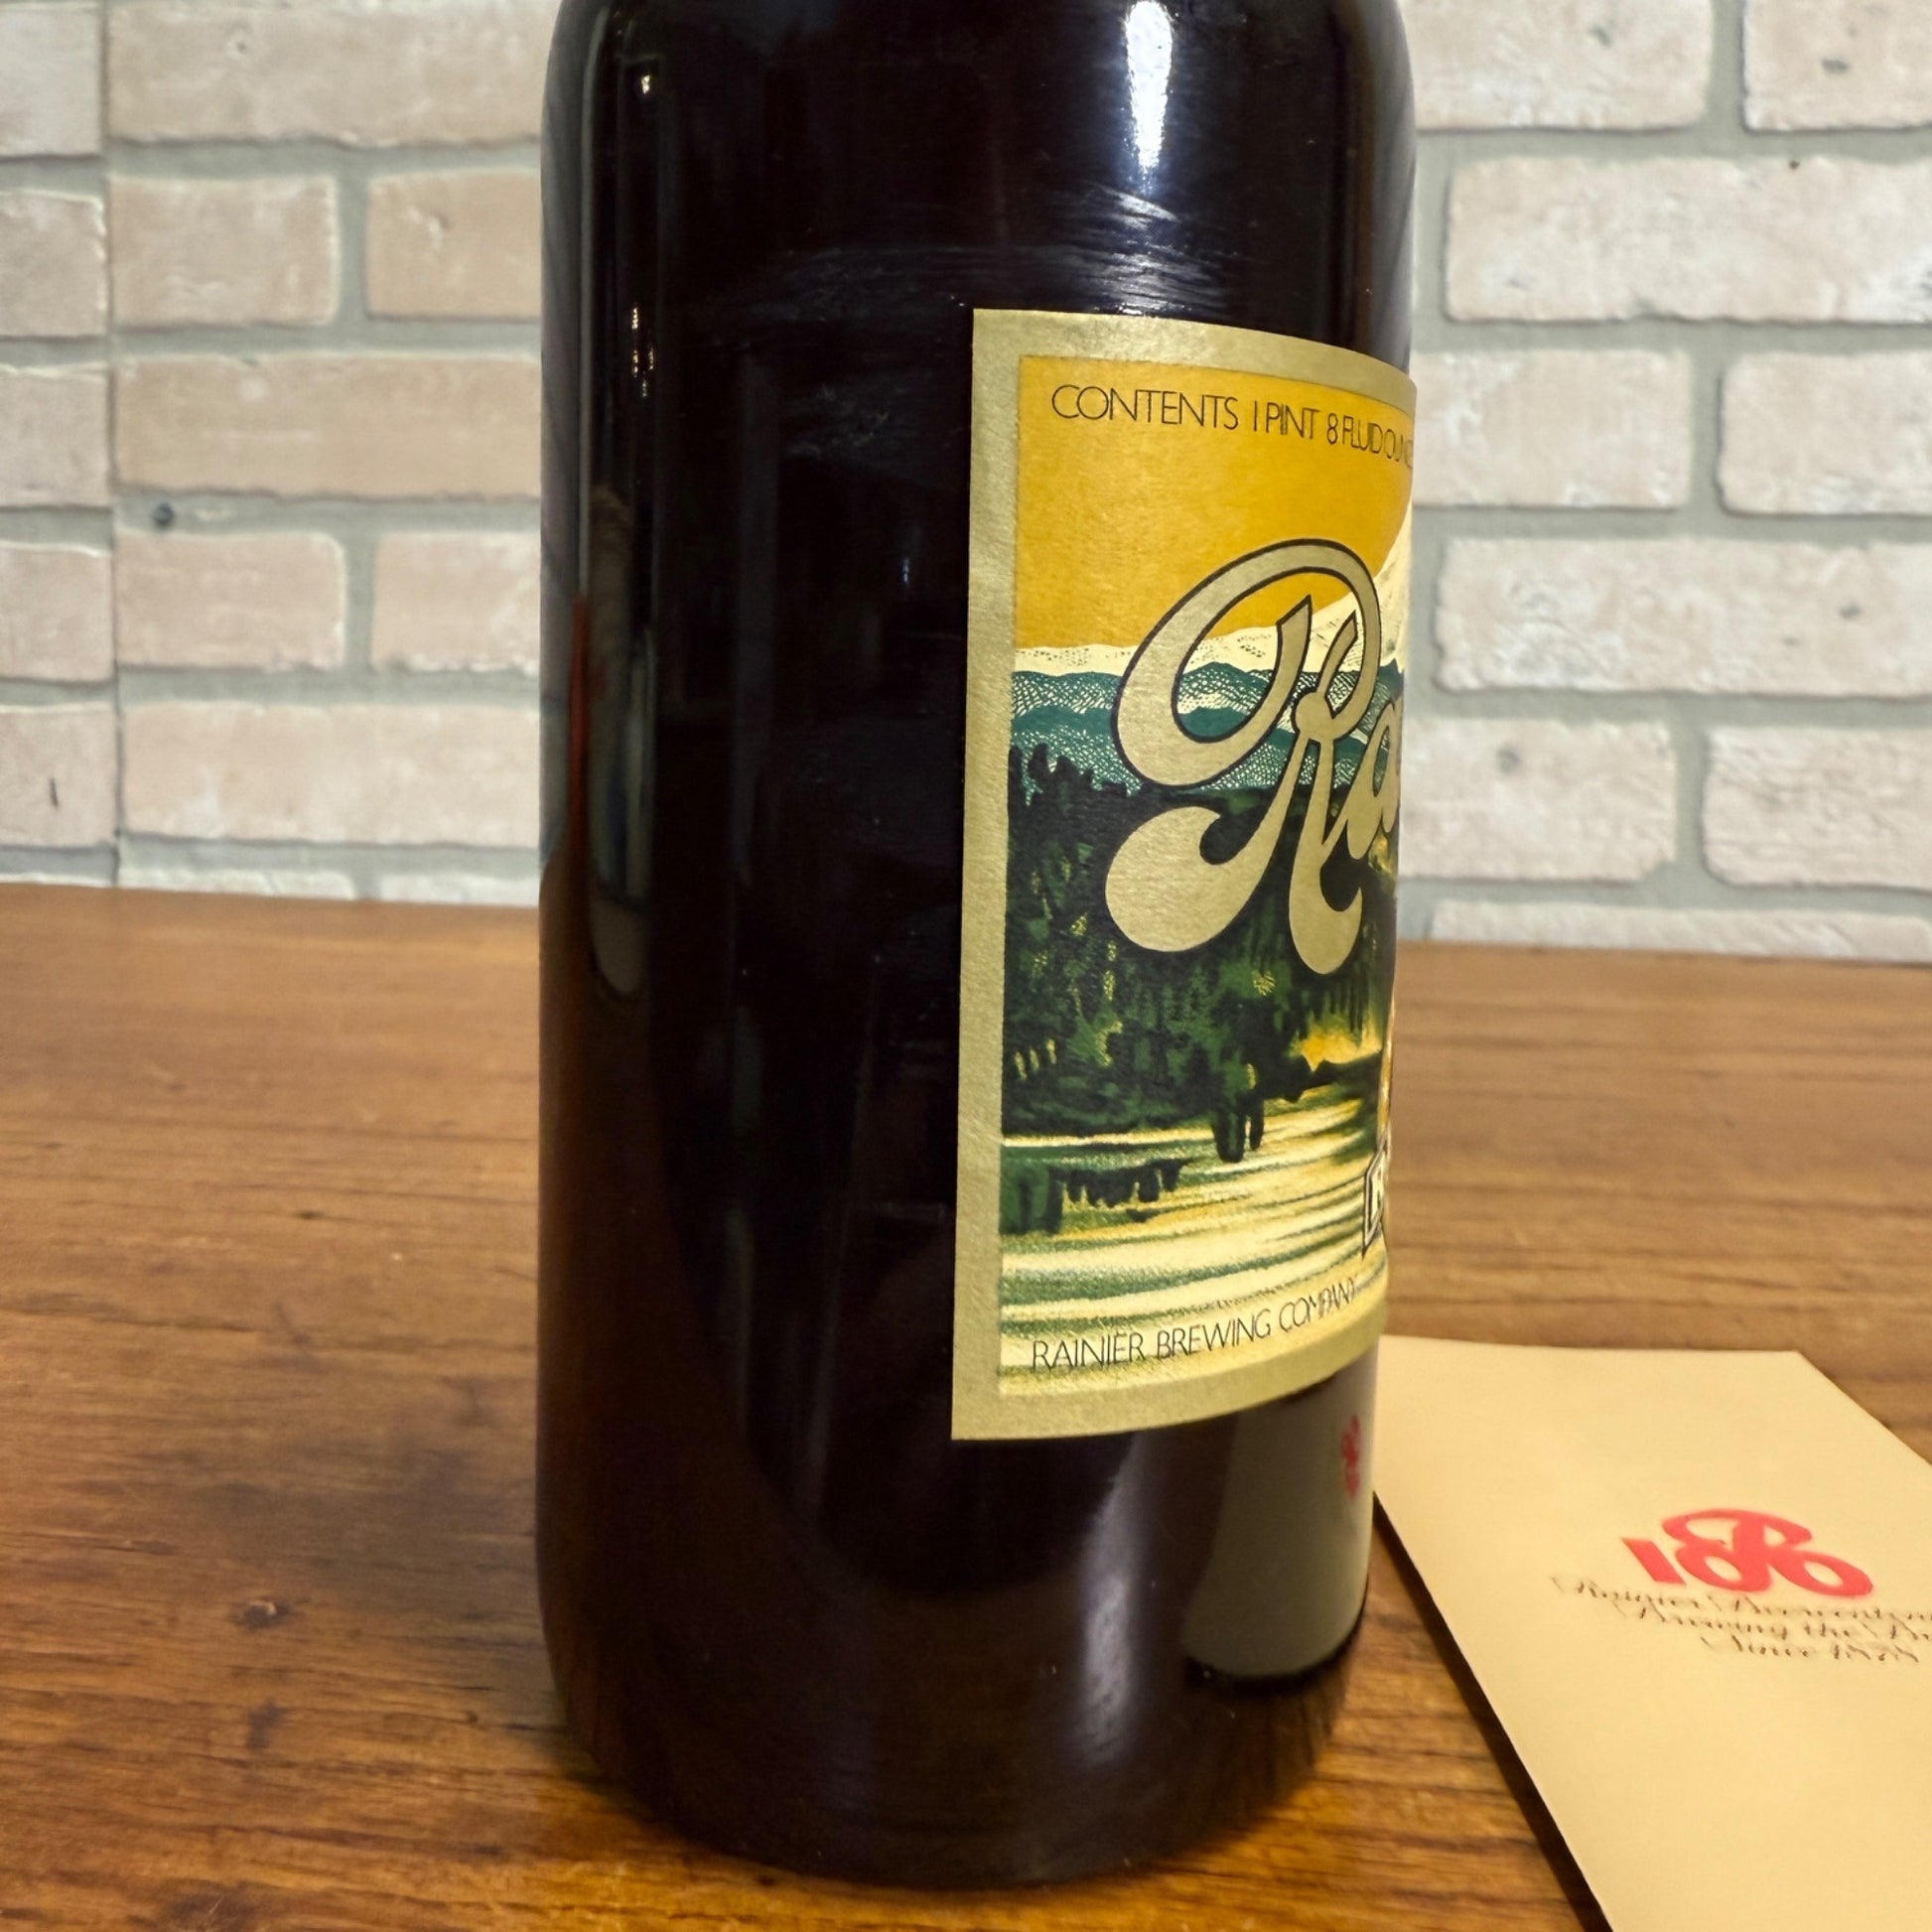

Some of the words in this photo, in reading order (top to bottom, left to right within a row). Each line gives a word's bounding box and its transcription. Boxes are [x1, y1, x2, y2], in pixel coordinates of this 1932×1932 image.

[1051, 384, 1239, 430] CONTENTS
[1265, 401, 1320, 440] PINT
[1326, 412, 1339, 446] 8
[1341, 415, 1384, 455] FLUID
[1032, 1330, 1147, 1373] RAINIER
[1156, 1309, 1273, 1360] BREWING
[1278, 1277, 1358, 1333] COMPANY
